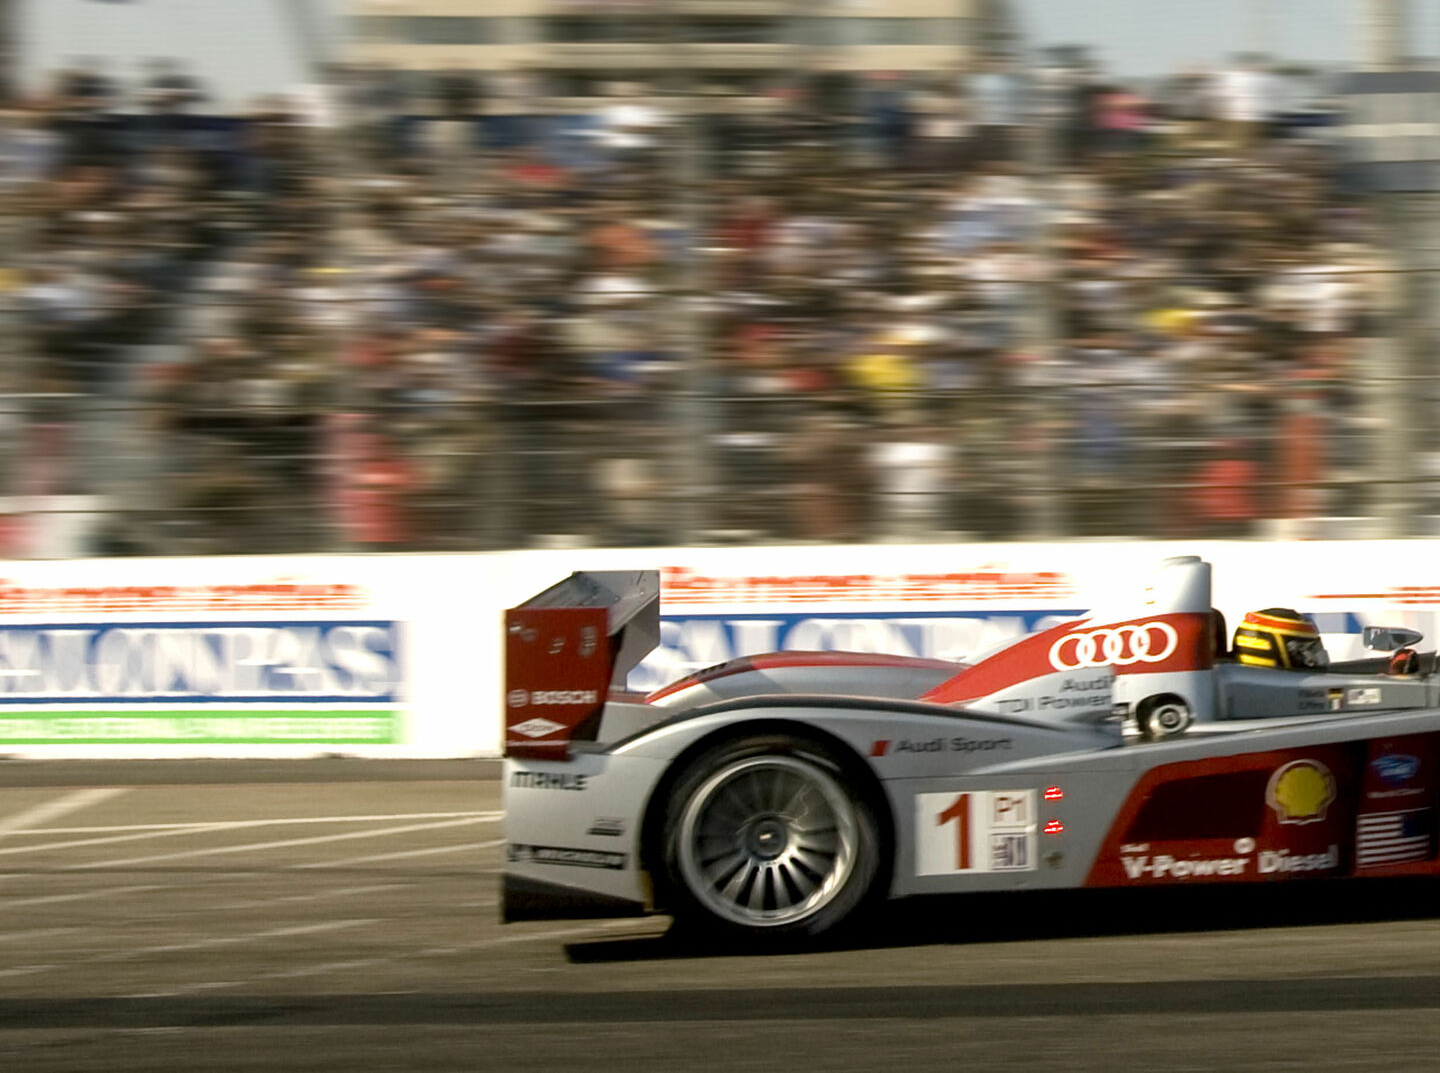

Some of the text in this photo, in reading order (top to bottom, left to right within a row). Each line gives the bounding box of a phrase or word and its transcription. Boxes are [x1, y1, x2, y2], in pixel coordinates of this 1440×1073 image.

[531, 690, 597, 705] BOSCH
[895, 736, 1012, 754] Audi Sport
[511, 771, 587, 791] MAHLE
[936, 793, 972, 870] 1
[1120, 843, 1339, 878] V-Power Diesel
